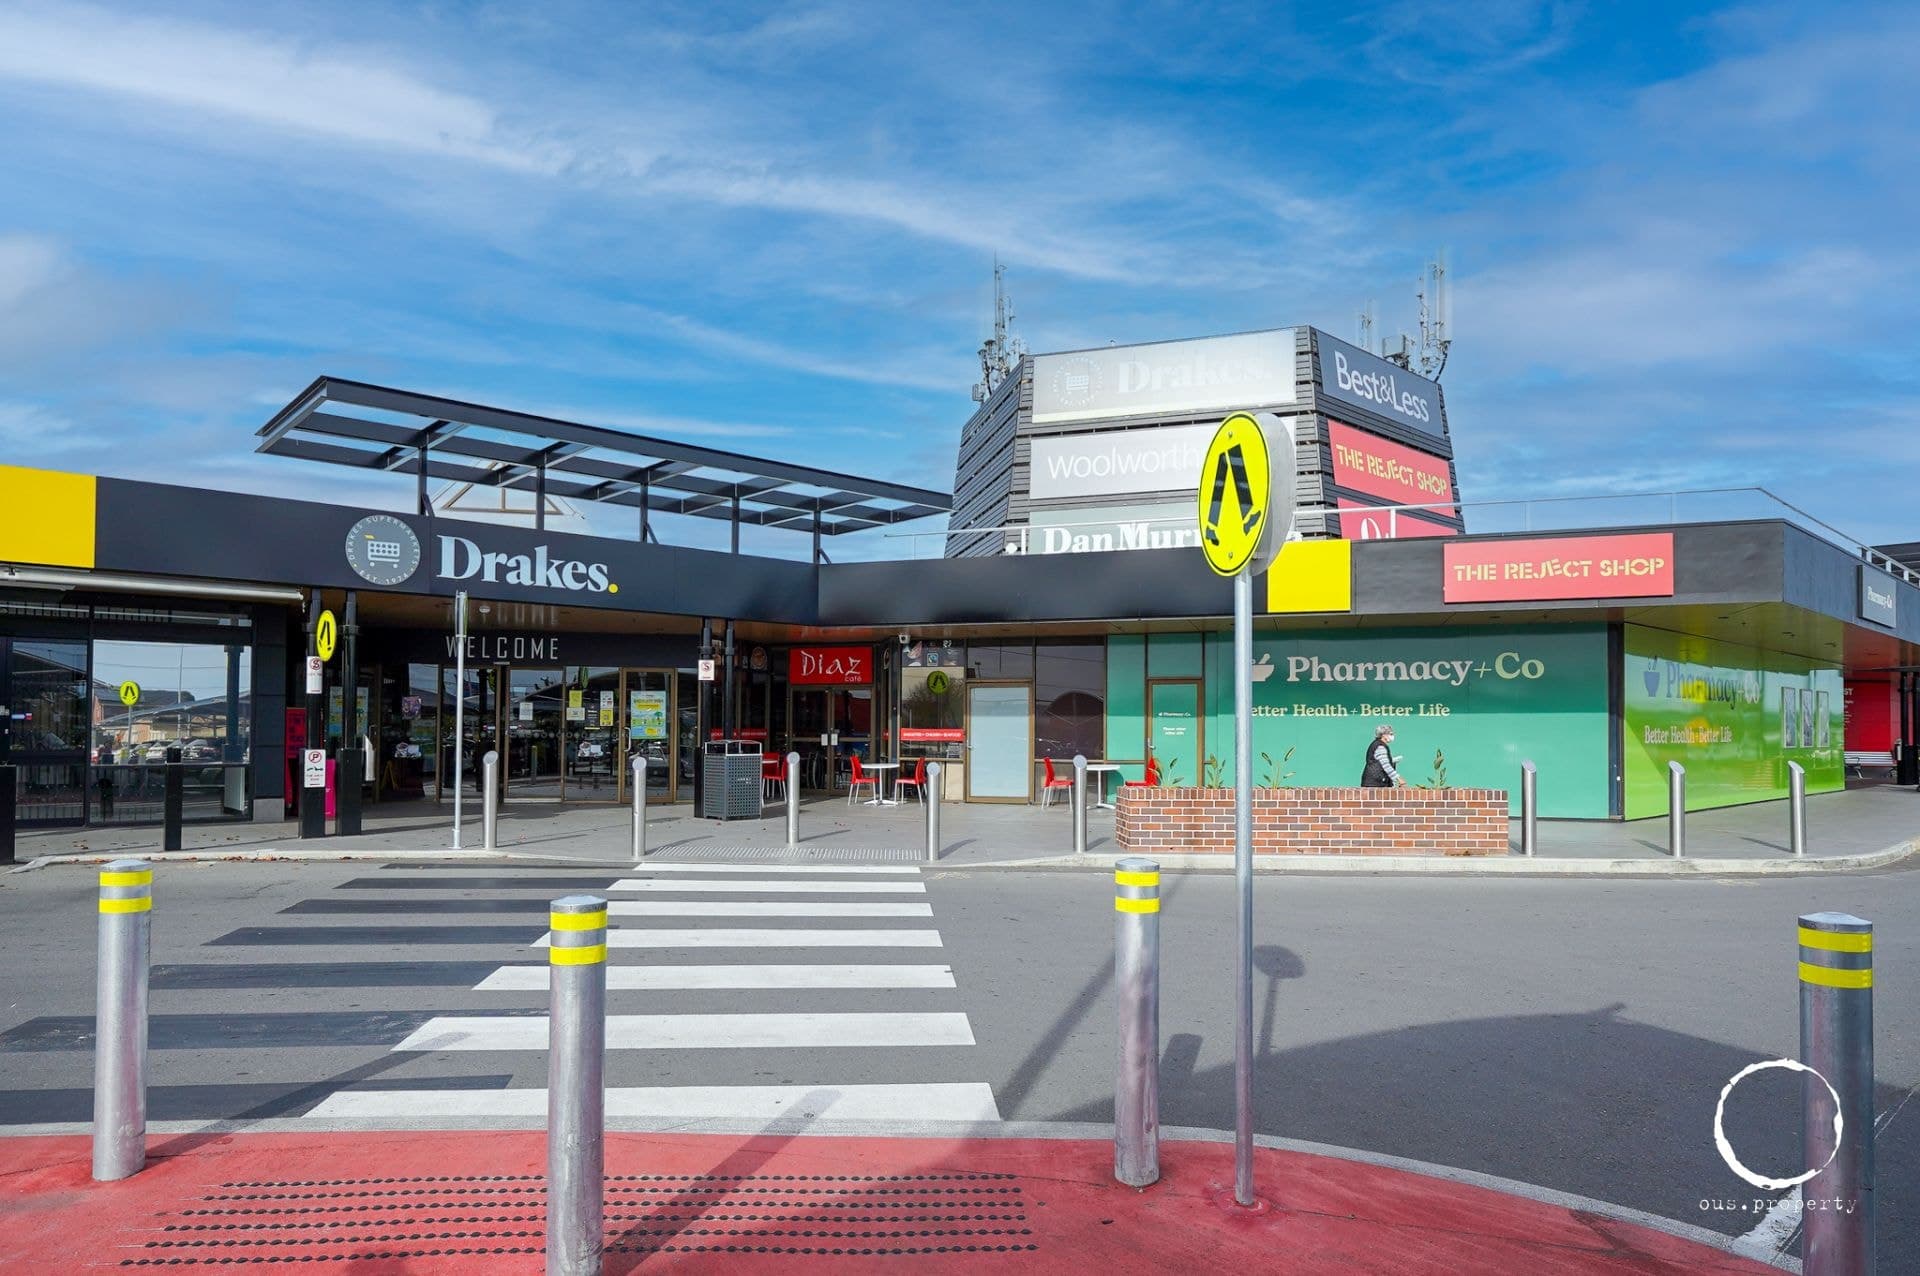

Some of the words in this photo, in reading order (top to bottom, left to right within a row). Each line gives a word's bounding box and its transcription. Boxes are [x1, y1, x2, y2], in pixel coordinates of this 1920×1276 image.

[1336, 443, 1364, 472] THE
[1366, 453, 1414, 489] REJECT
[1416, 471, 1447, 497] SHOP
[1454, 563, 1497, 581] THE
[1504, 558, 1592, 580] REJECT
[1600, 557, 1665, 577] SHOP
[445, 635, 559, 660] WELCOME
[800, 650, 861, 676] Diaz
[1252, 704, 1288, 717] etter
[1419, 704, 1450, 717] Life
[1644, 725, 1669, 744] Better
[1720, 726, 1732, 743] Life
